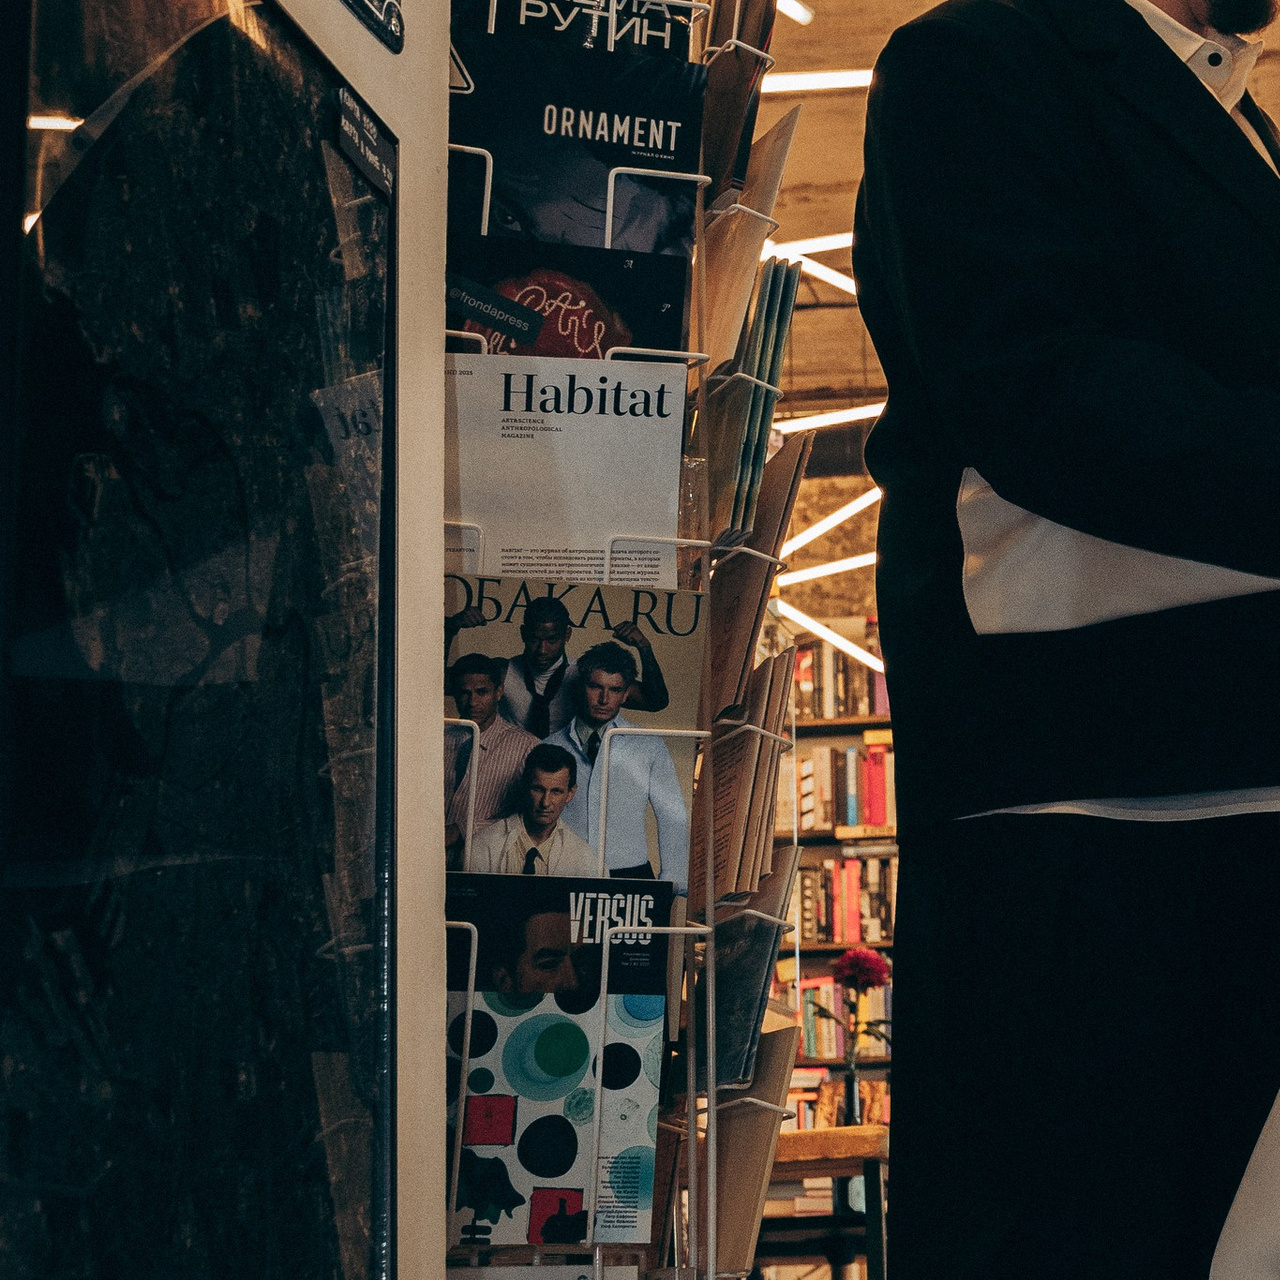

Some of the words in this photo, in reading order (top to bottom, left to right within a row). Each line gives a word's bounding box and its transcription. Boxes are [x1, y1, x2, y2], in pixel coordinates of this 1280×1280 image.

[542, 104, 682, 152] ORNAMENT
[449, 286, 530, 333] @frondapress
[500, 372, 673, 418] Habitat
[501, 425, 563, 433] ANTHROPOLOGICAL
[445, 574, 616, 631] ОБАКА
[569, 892, 655, 946] VERSUS
